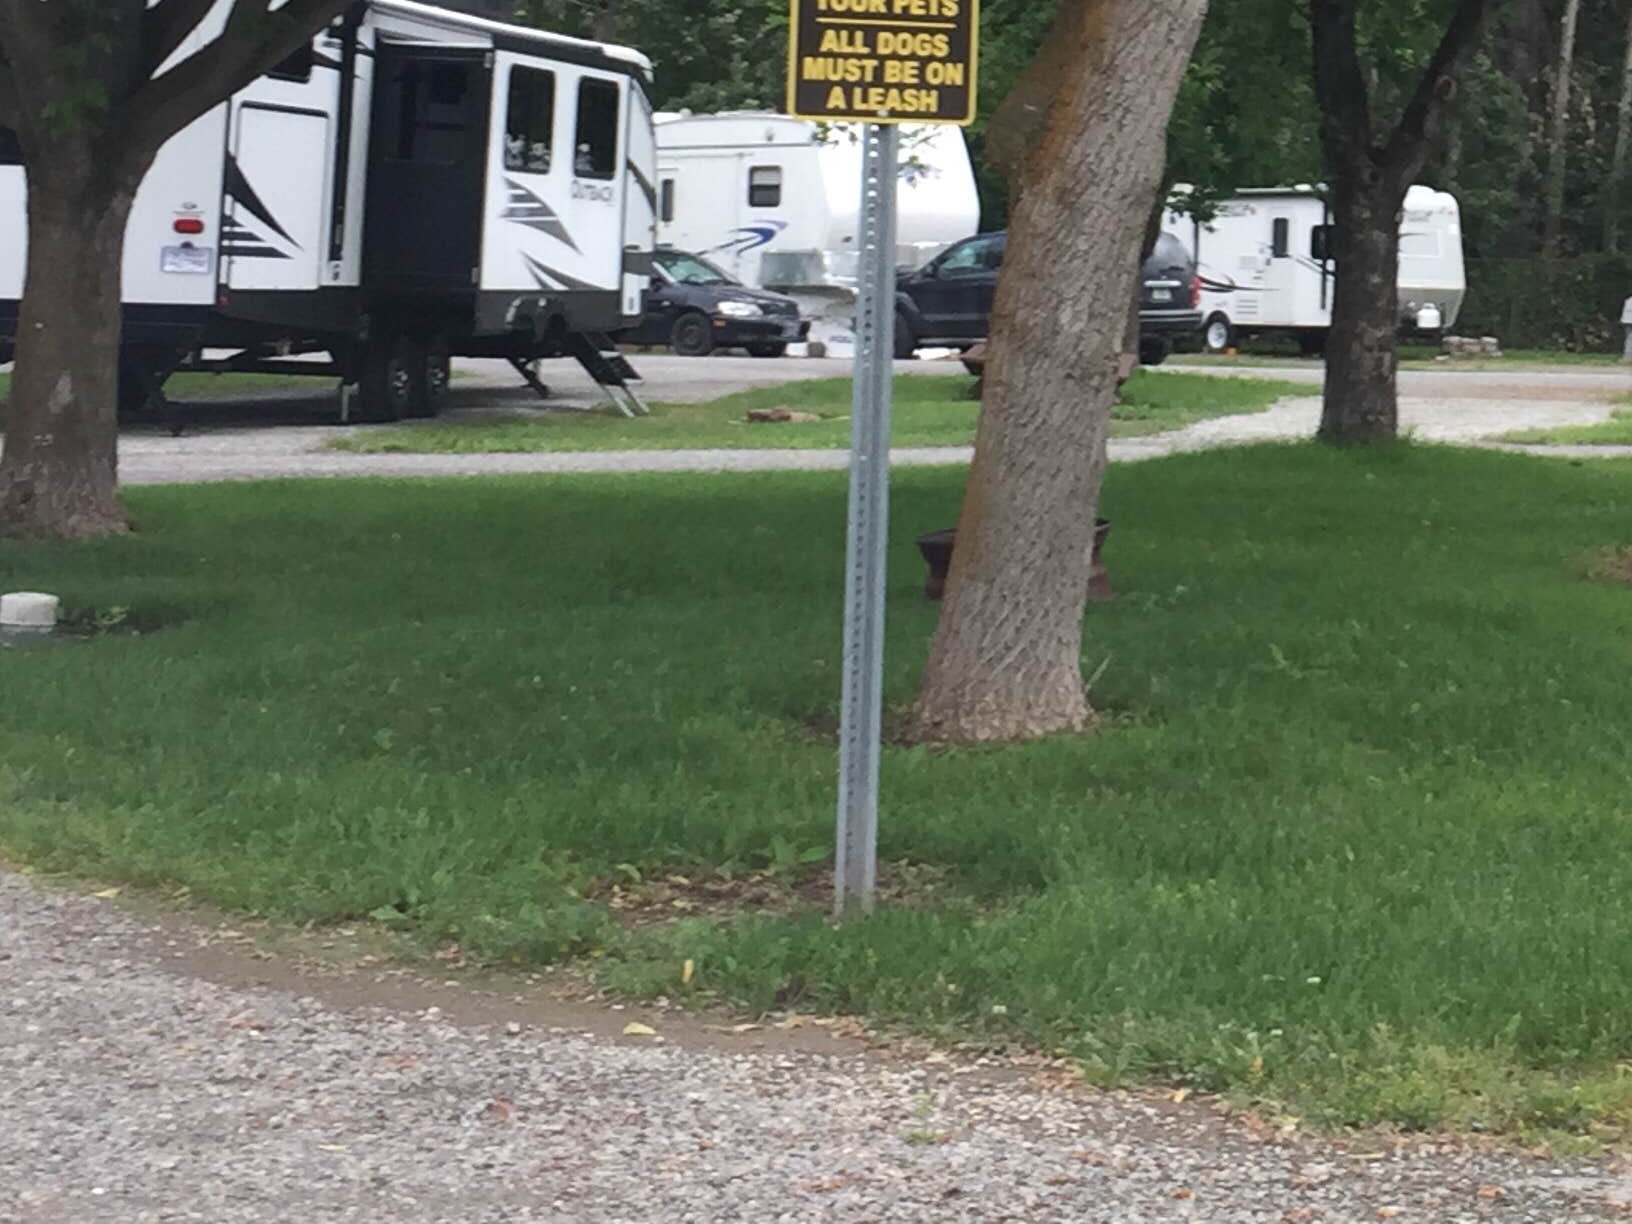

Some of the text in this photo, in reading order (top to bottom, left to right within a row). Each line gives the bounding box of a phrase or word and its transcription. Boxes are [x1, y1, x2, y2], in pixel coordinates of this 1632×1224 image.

[819, 29, 950, 58] ALL DOGS
[803, 56, 964, 86] MUST BE ON
[825, 86, 940, 113] A LEASH
